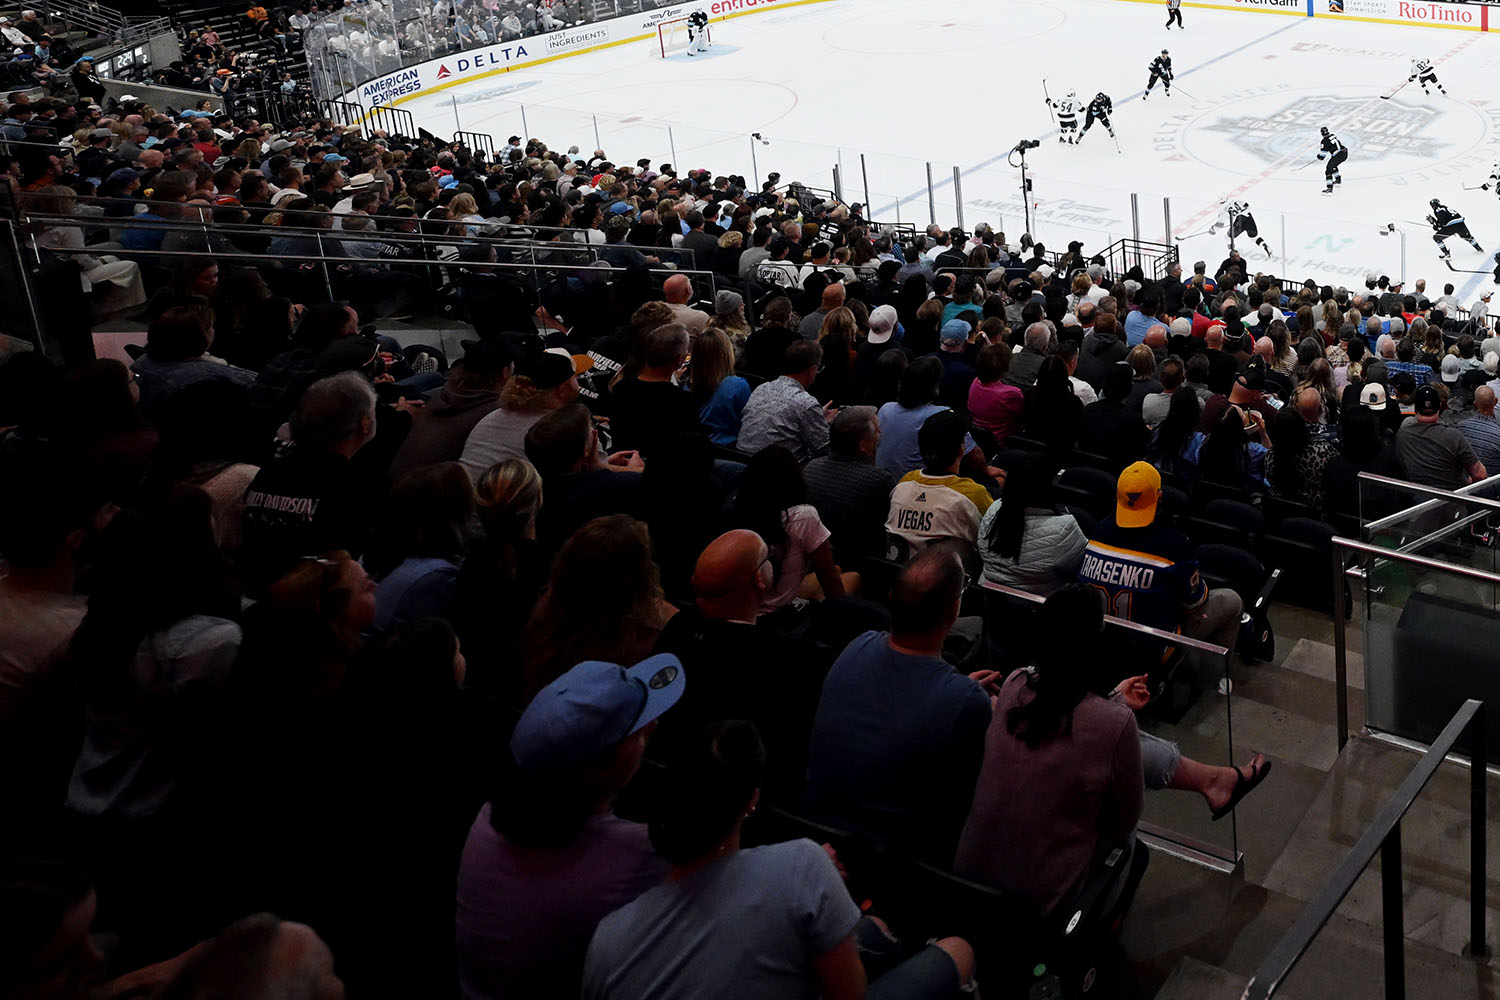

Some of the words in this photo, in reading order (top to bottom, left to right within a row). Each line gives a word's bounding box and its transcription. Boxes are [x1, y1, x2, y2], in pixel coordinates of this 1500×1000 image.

[1399, 1, 1427, 19] Rio
[1428, 3, 1473, 24] Tinto
[548, 31, 567, 42] JUST
[549, 30, 607, 49] INGREDIENTS
[457, 45, 529, 73] DELTA
[1416, 59, 1429, 72] 82
[363, 69, 418, 98] AMERICAN
[371, 80, 422, 106] EXPRESS
[1060, 101, 1073, 113] 54
[897, 508, 934, 532] VEGAS
[1080, 553, 1154, 590] TARASENKO
